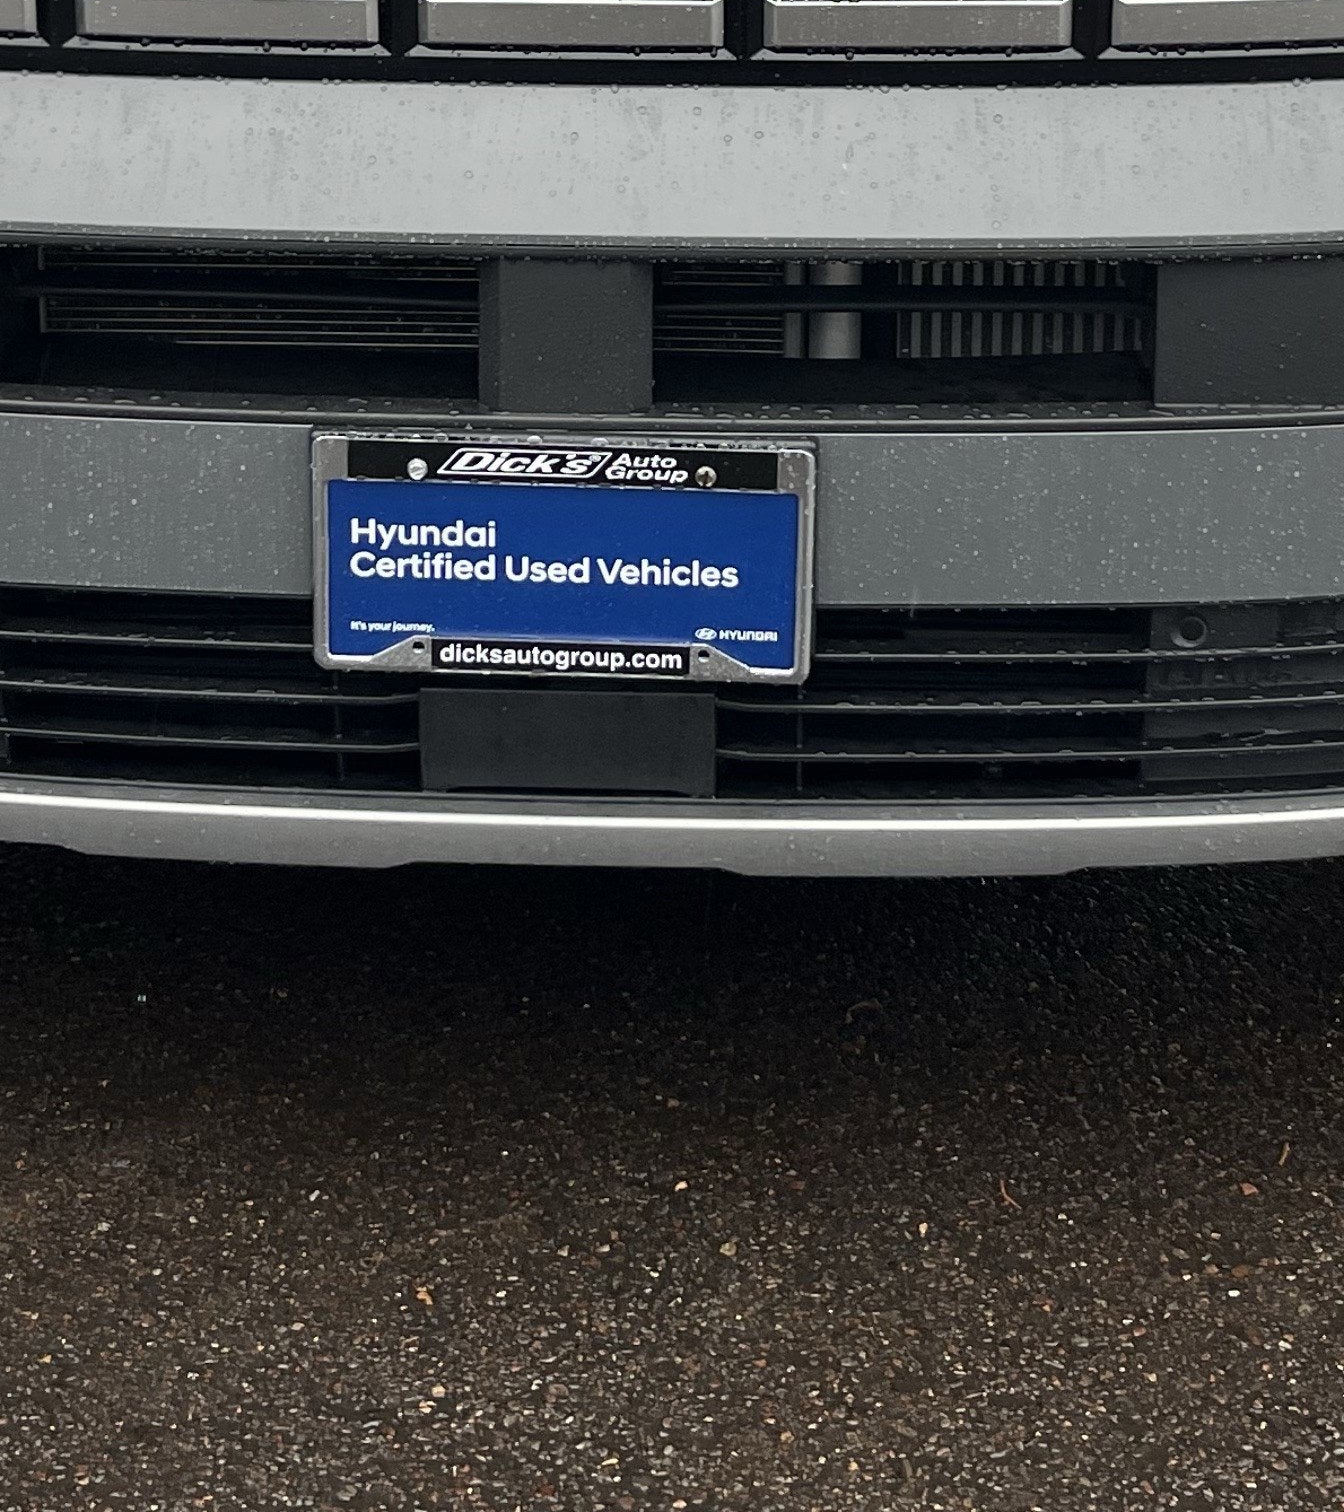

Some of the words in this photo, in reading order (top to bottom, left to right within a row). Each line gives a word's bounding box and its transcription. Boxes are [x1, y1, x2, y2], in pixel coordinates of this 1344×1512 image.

[450, 450, 594, 475] Dick's
[611, 452, 678, 469] Auto
[605, 465, 689, 484] Group
[350, 517, 497, 550] Hyundai
[349, 551, 496, 582] Certified
[504, 555, 591, 585] Used
[597, 558, 739, 589] Vehicles
[368, 622, 392, 632] your
[718, 629, 778, 642] HYUNDAI
[439, 643, 683, 672] dicksautogroup.com
